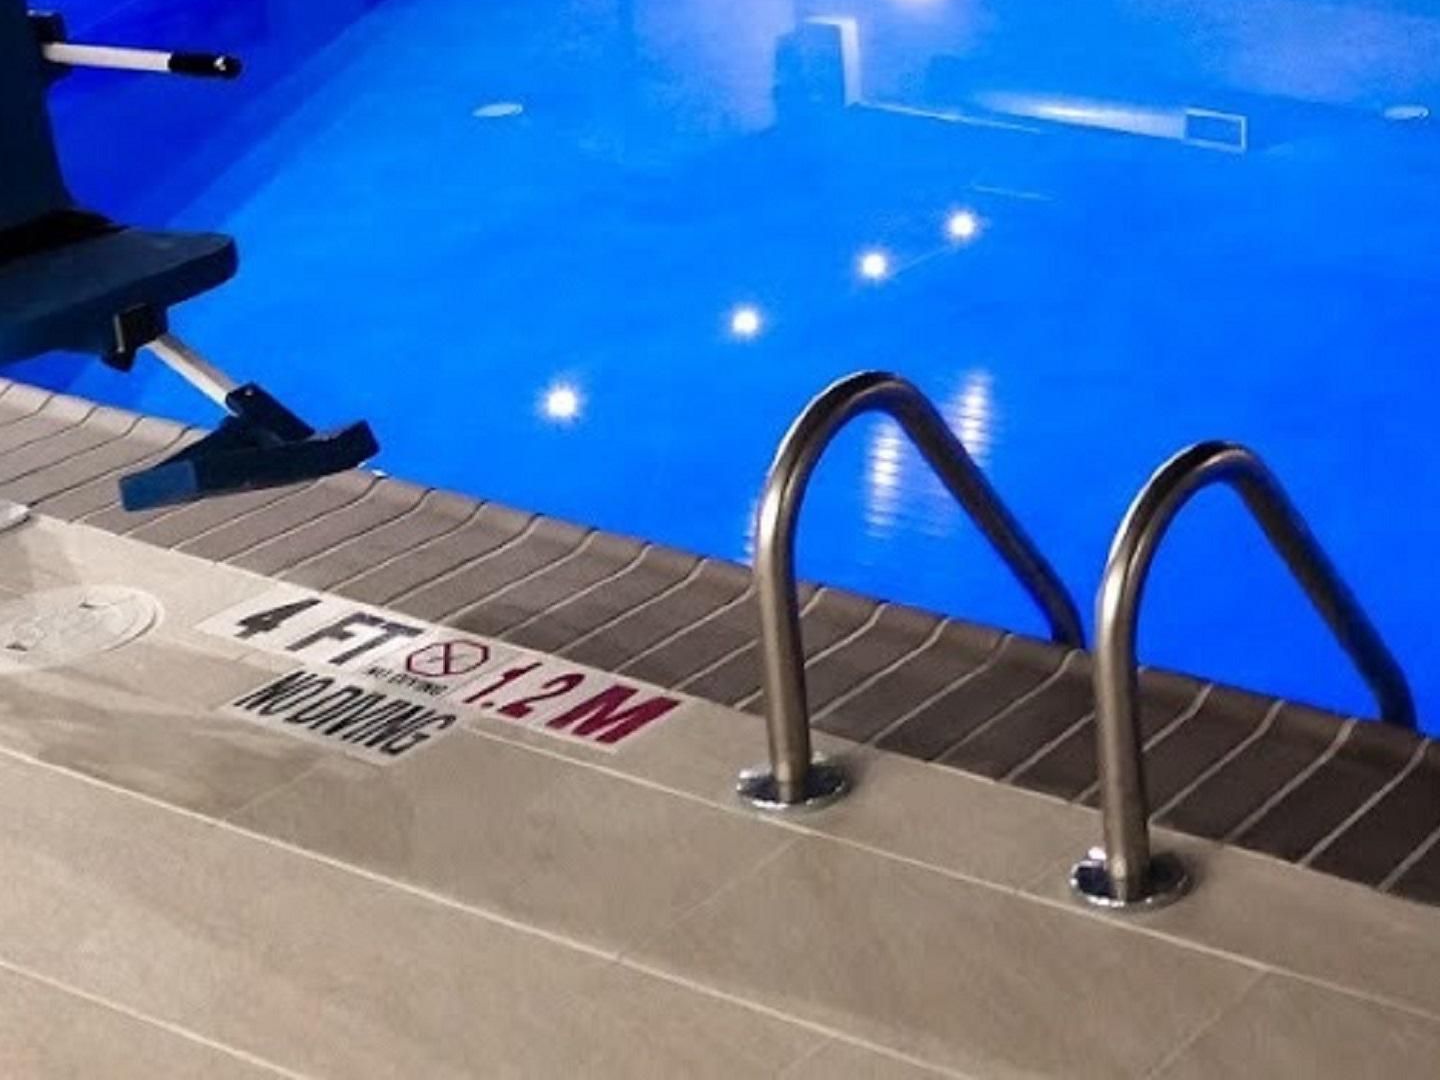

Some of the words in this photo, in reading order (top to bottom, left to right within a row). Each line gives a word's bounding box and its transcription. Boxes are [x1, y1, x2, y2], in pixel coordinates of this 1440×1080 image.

[233, 598, 322, 639] 4
[285, 612, 424, 666] FT
[462, 662, 586, 719] 1.2
[545, 684, 682, 744] M
[233, 670, 335, 716] NO
[283, 685, 457, 756] DIVING
